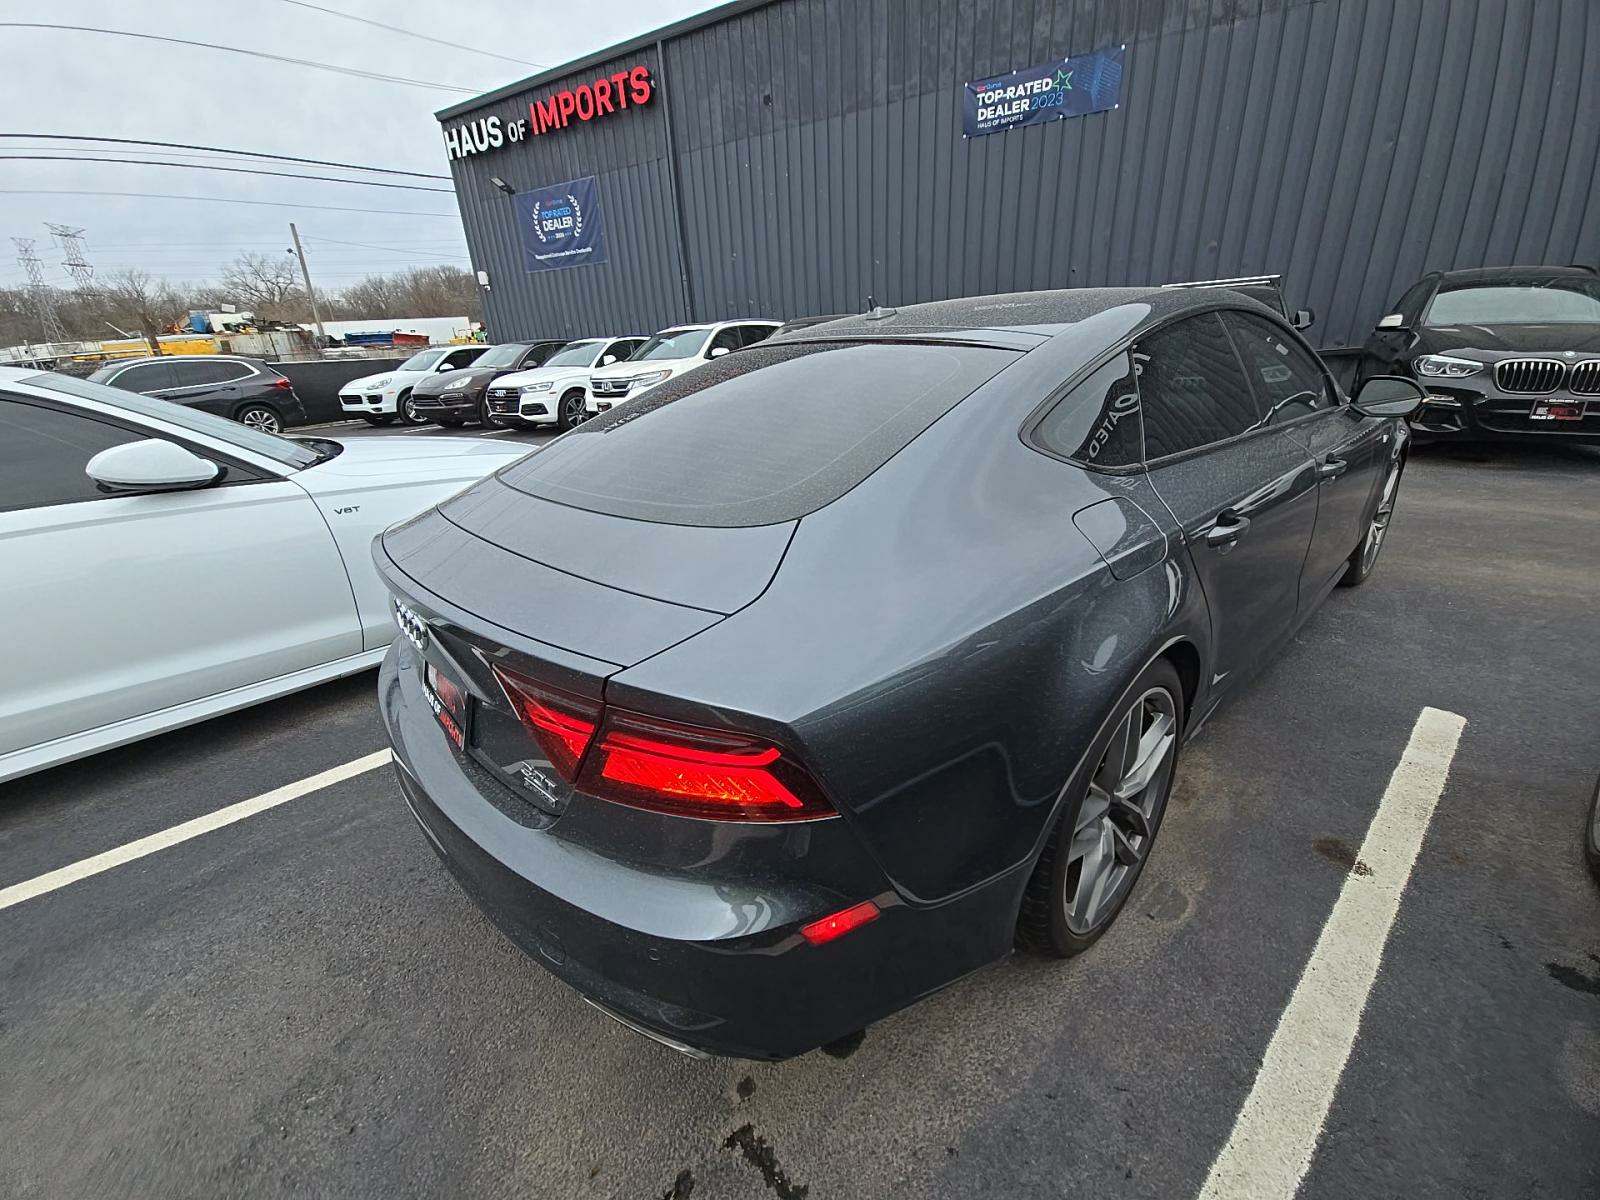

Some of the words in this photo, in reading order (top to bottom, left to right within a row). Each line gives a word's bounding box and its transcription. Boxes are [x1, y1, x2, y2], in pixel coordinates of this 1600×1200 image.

[976, 77, 1053, 106] TOP-RATED
[977, 98, 1030, 121] DEALER
[1030, 91, 1064, 110] 2023
[443, 115, 504, 161] HAUS
[507, 118, 526, 143] OF
[529, 65, 652, 136] IMPORTS
[542, 216, 574, 232] DEALER
